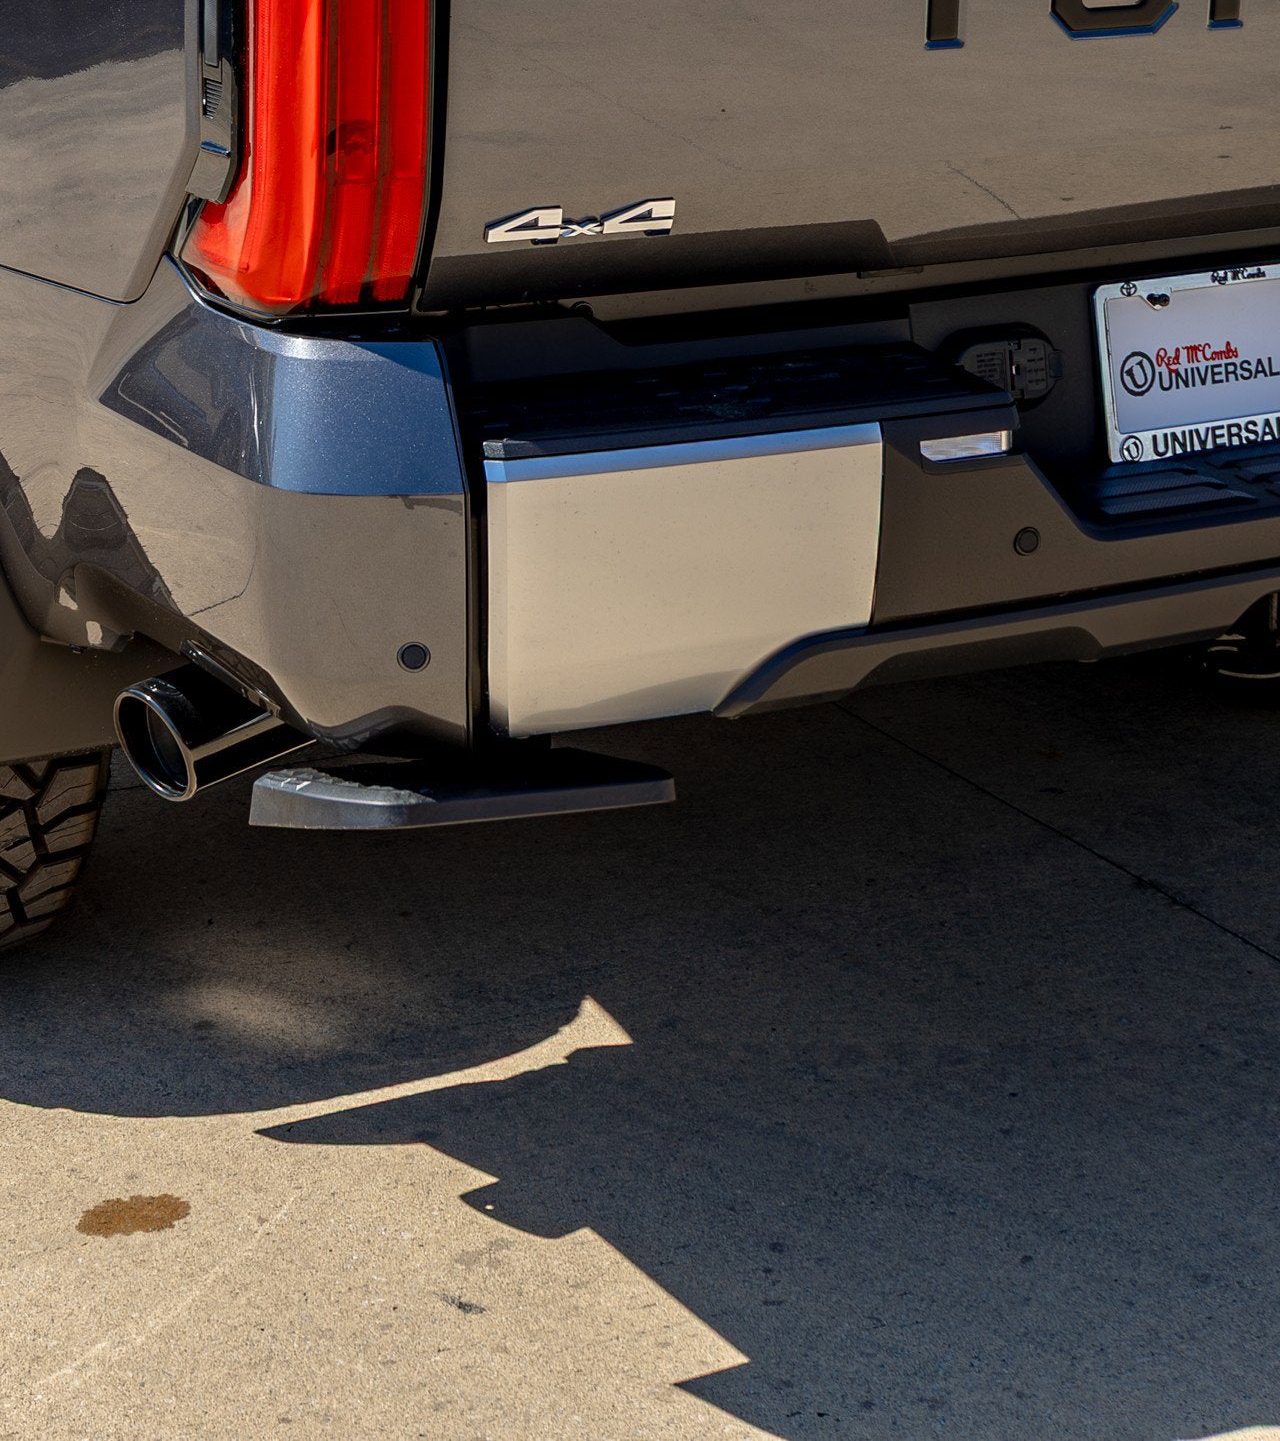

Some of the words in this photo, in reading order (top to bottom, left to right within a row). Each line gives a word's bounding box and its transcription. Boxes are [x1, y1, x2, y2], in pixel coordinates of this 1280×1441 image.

[1155, 346, 1181, 374] Red
[1182, 340, 1239, 364] McCombs
[1158, 356, 1280, 392] UNIVERSAL
